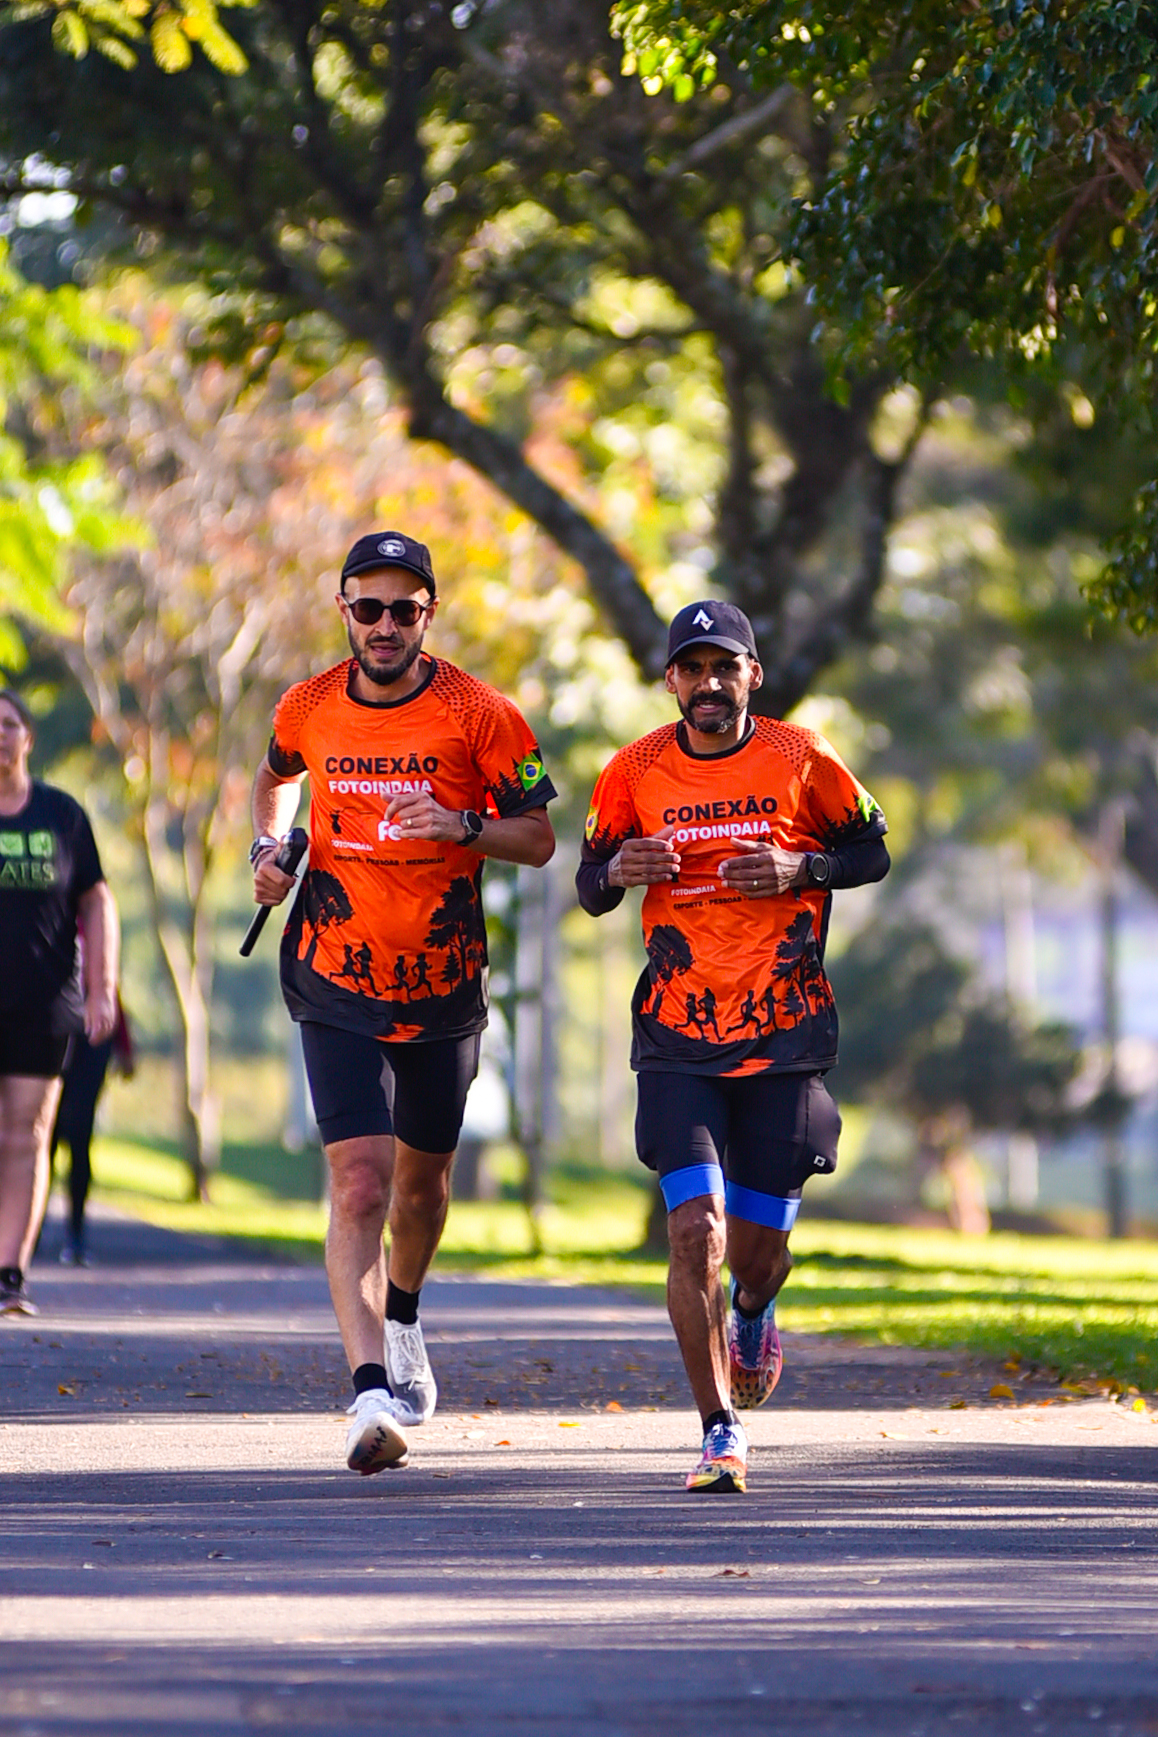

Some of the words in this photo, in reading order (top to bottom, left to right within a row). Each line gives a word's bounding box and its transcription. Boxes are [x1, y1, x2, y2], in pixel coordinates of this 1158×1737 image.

[325, 752, 439, 775] CONEXÃO
[328, 780, 433, 794] FOTOINDAIA
[663, 795, 778, 825] CONEXÃO
[671, 885, 716, 896] FOTOINDAIA
[709, 896, 742, 906] PESSOAS
